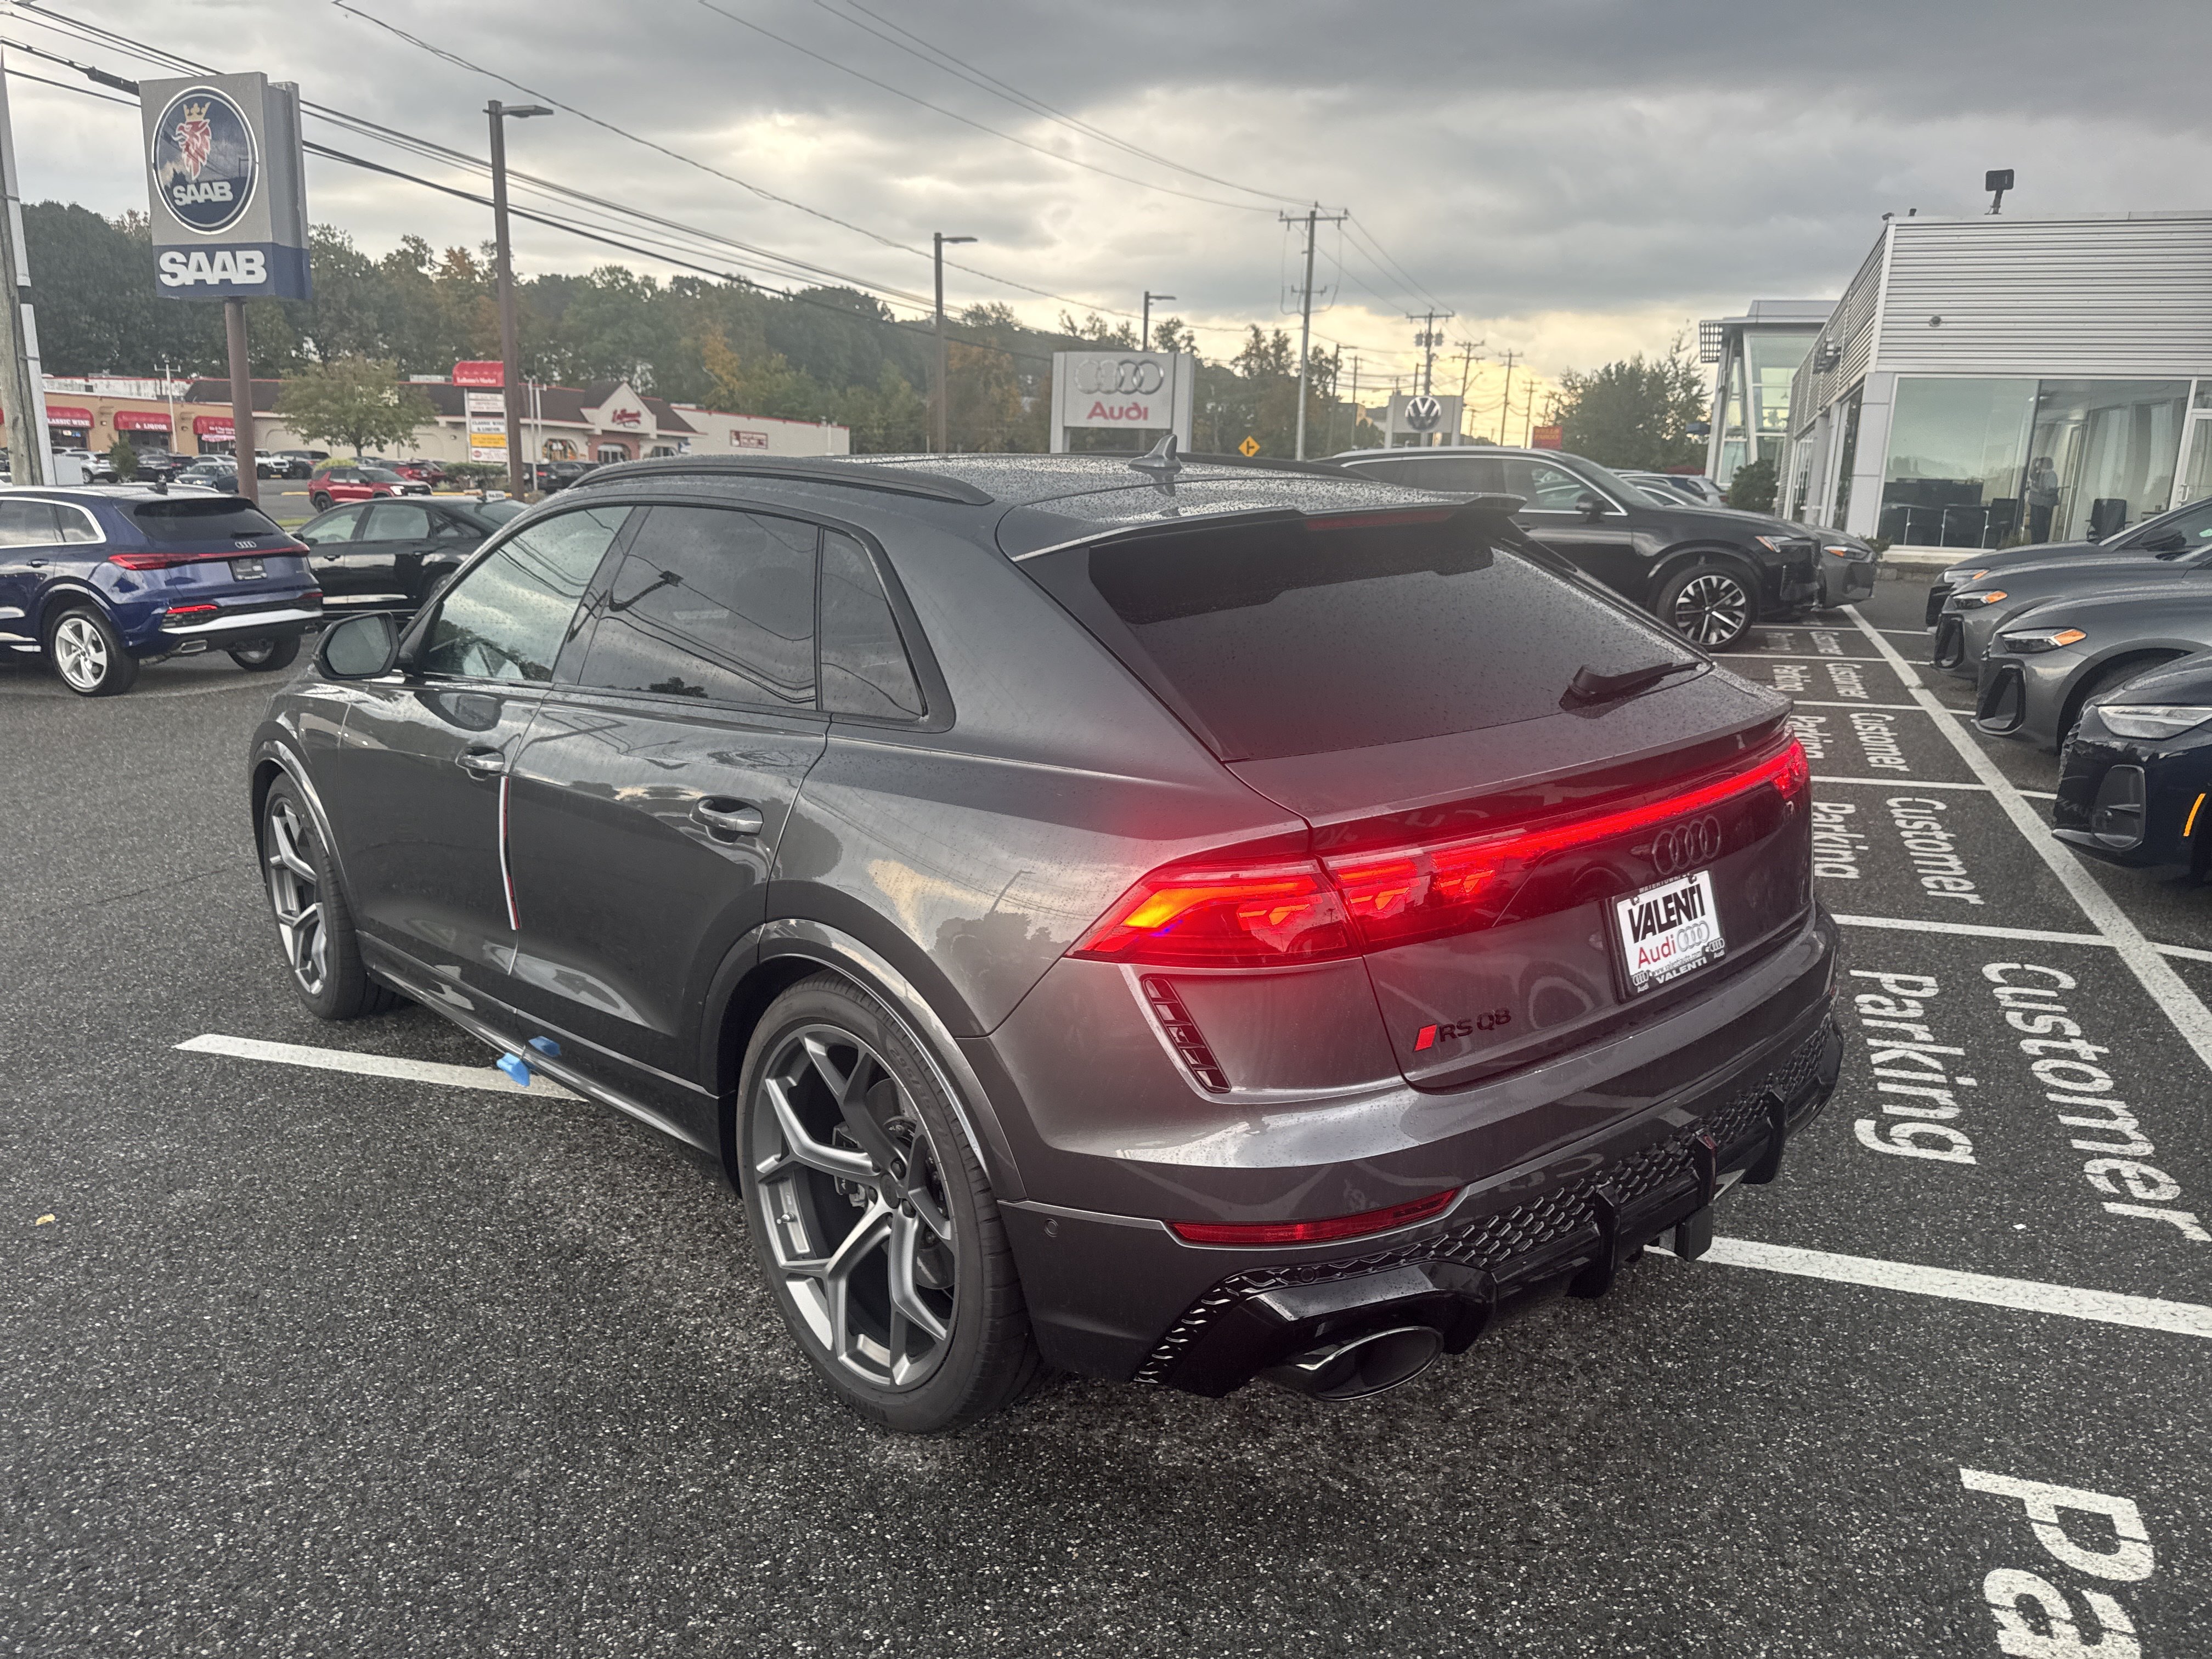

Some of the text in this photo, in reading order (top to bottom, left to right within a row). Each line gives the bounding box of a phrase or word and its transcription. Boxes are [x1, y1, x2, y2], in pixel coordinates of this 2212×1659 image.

[173, 181, 233, 206] SAAB
[159, 250, 267, 287] SAAB
[1087, 401, 1149, 421] Audi
[1849, 713, 1910, 771] Customer
[1886, 797, 1984, 905] Customer
[1638, 934, 1676, 969] Audi
[1656, 956, 1707, 984] VALENTI
[1438, 1007, 1511, 1042] RS Q8
[1849, 969, 1977, 1165] Parking
[1982, 962, 2212, 1242] Customer
